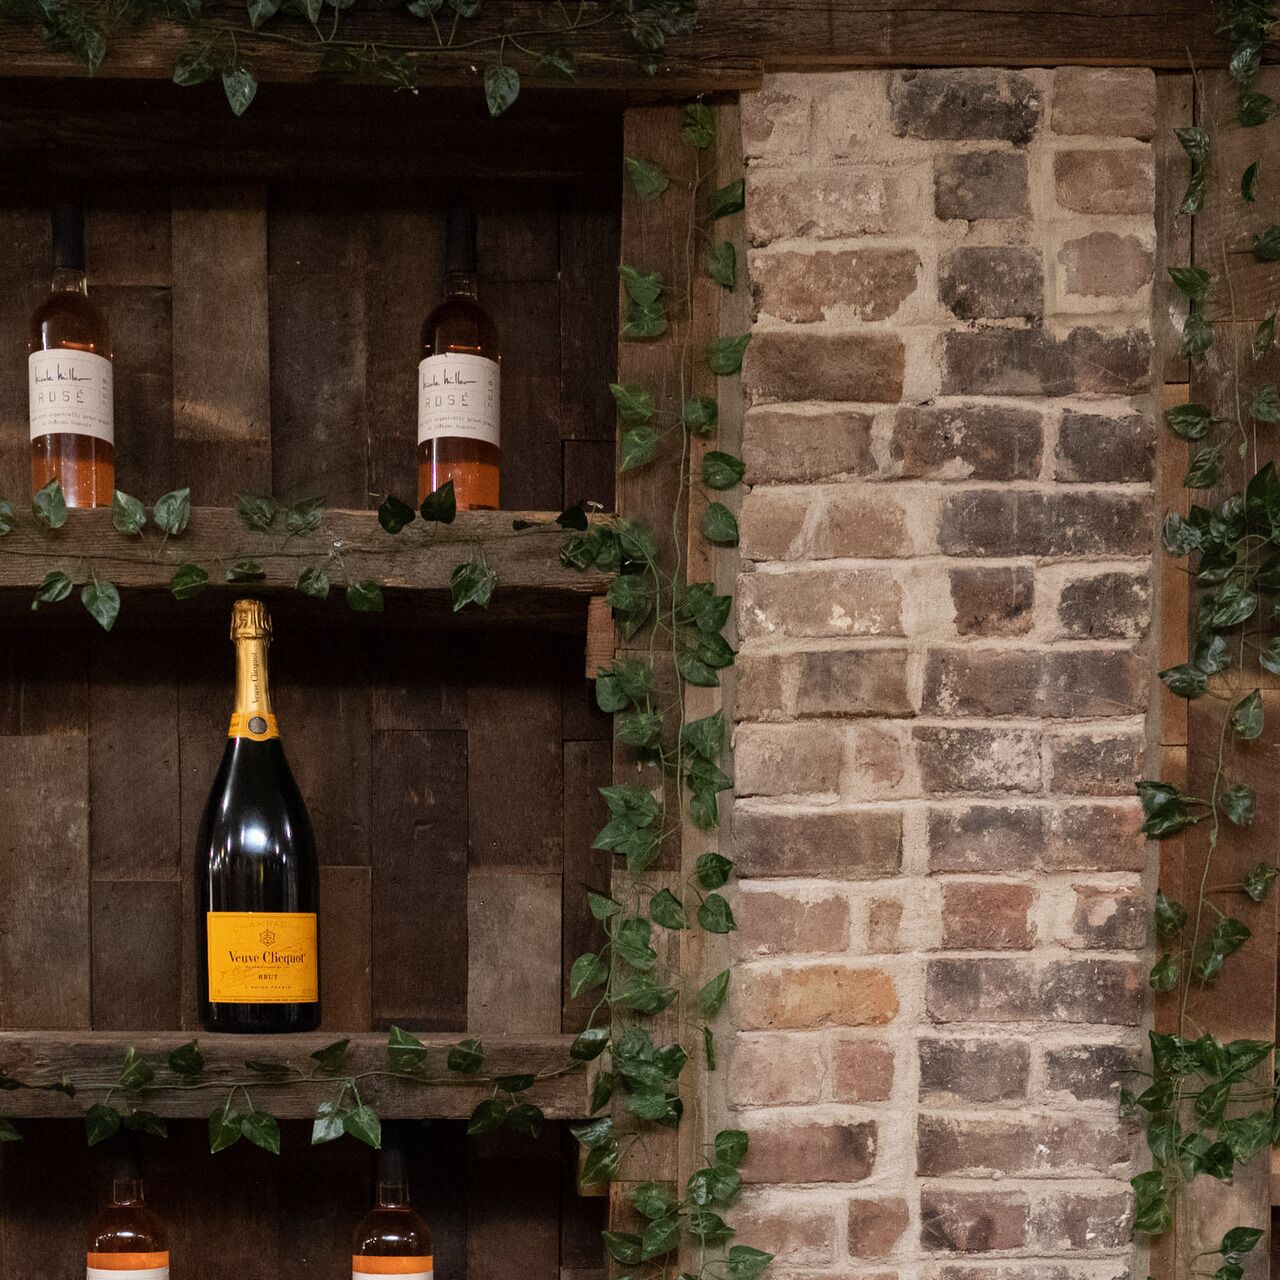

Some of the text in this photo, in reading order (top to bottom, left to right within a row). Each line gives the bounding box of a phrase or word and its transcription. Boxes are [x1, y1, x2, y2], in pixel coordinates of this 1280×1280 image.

[38, 389, 84, 404] ROSÉ
[425, 392, 470, 408] ROSÉ
[228, 950, 305, 965] Veuve Clicquot
